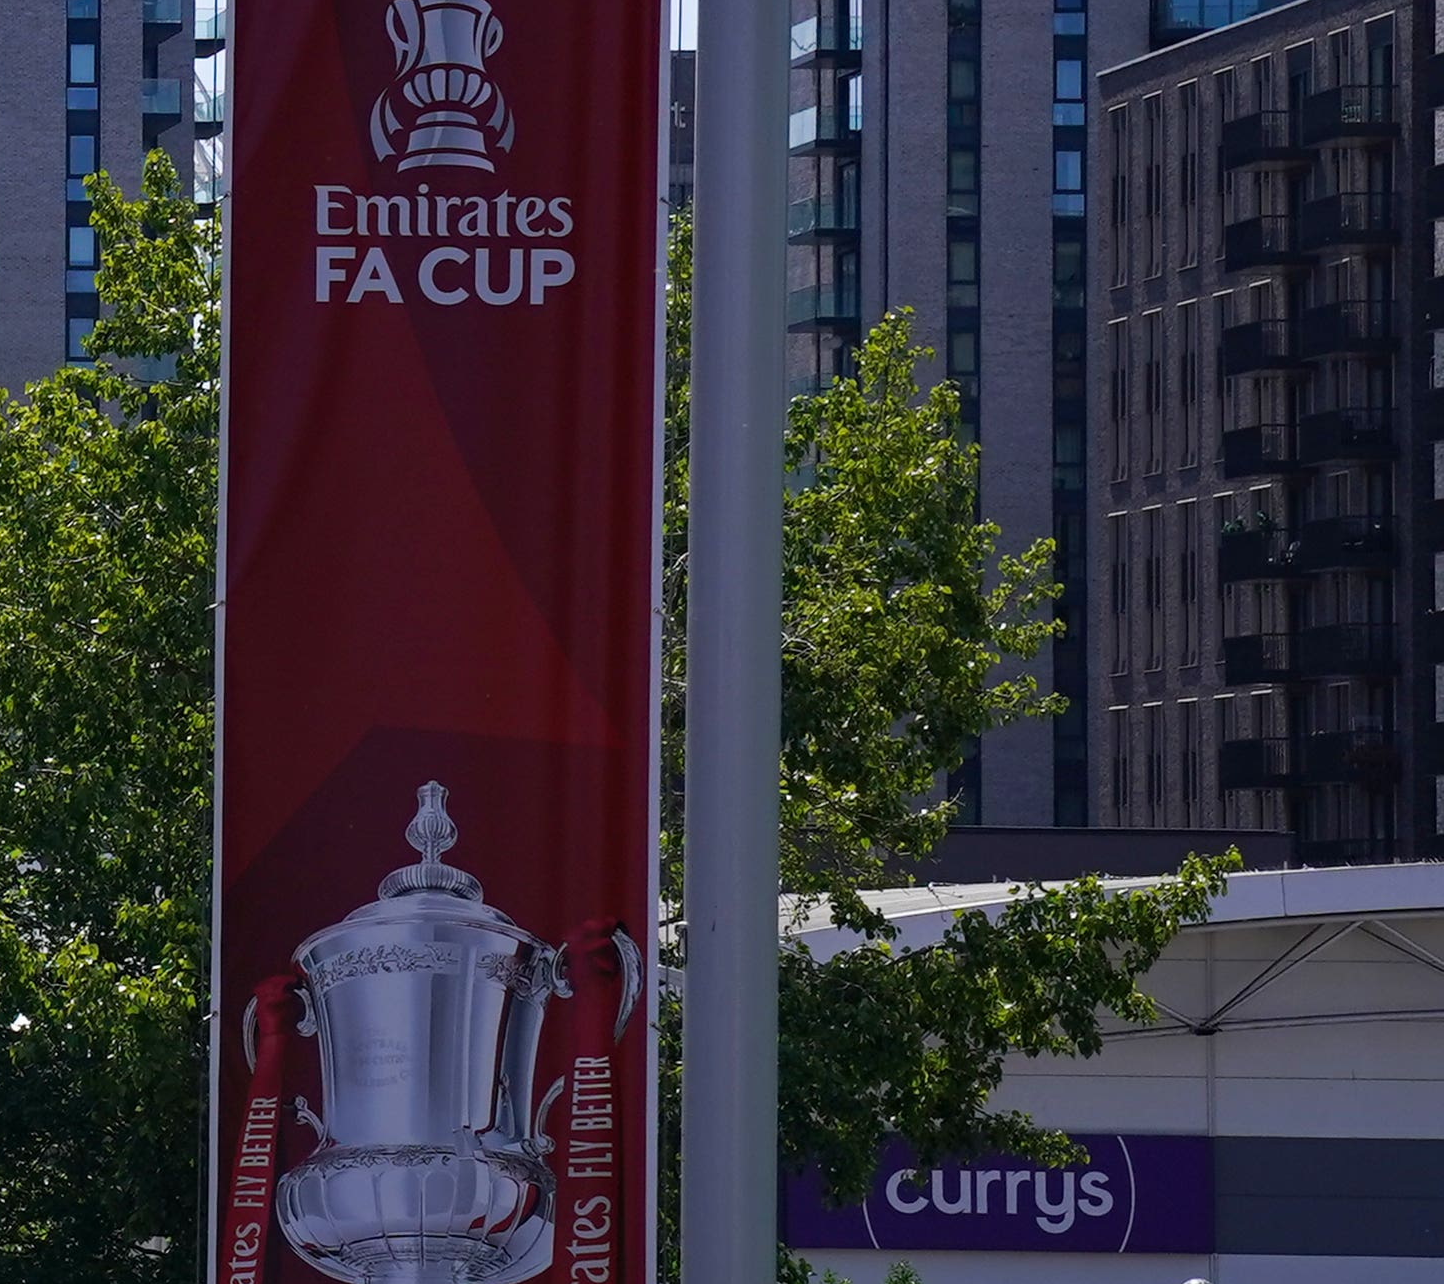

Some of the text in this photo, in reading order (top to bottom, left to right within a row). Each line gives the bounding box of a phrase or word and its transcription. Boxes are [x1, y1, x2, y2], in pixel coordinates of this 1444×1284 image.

[313, 184, 574, 238] Emirates
[315, 246, 576, 305] FA CUP
[570, 1054, 612, 1135] BETTER
[242, 1095, 279, 1168] BETTER
[568, 1137, 612, 1179] FLY
[233, 1165, 267, 1209] FLY
[884, 1167, 1114, 1234] currys
